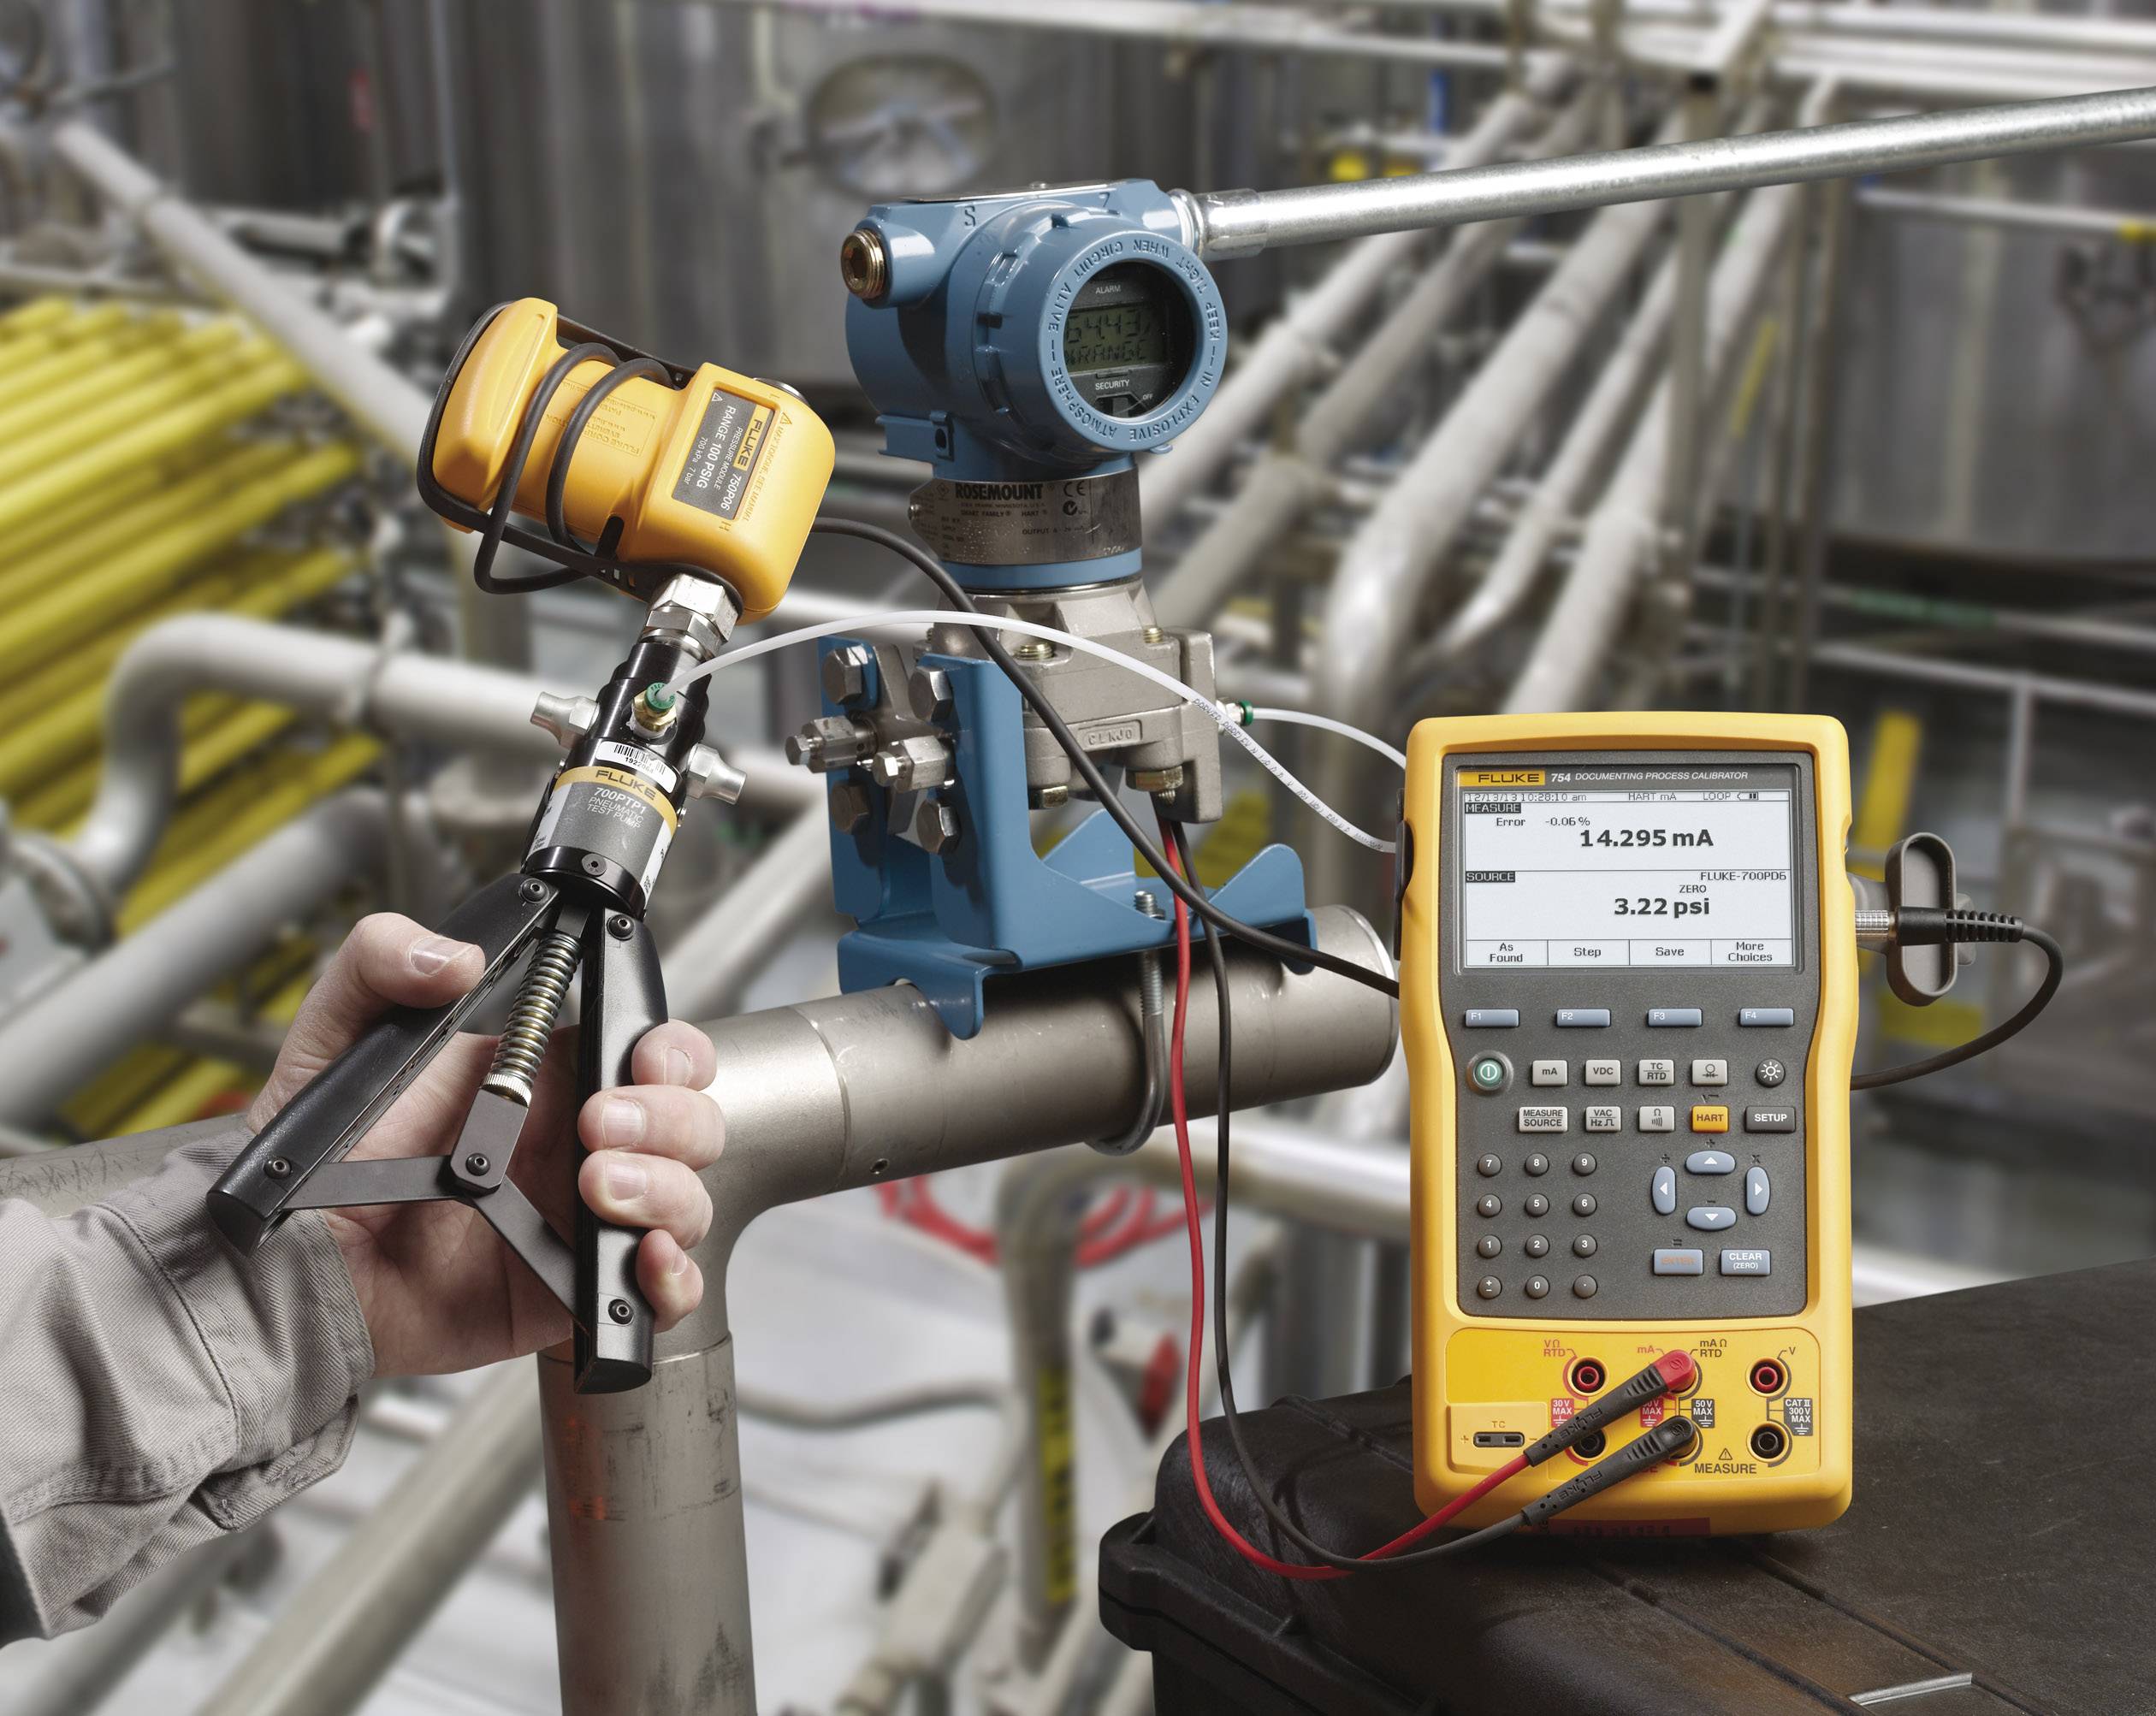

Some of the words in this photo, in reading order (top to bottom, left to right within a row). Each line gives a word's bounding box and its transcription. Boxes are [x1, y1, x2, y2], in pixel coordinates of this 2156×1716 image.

[1134, 239, 1169, 259] WHEN
[1074, 240, 1123, 281] CIRCUIT
[1176, 257, 1207, 294] TIGHT
[1095, 285, 1122, 294] ALARM
[1048, 281, 1072, 334] ALIVE
[1205, 302, 1220, 341] KEEP
[1201, 370, 1213, 388] IN
[1095, 380, 1130, 390] SECURITY
[1051, 367, 1117, 440] ATMOSPHERE
[715, 405, 737, 441] RANGE
[1129, 395, 1199, 441] EXPLOSIVE
[697, 437, 708, 452] 700
[726, 427, 743, 461] PRESSURE
[737, 419, 763, 467] FLUKE
[692, 450, 703, 463] kPa
[708, 442, 722, 461] 100
[684, 472, 694, 485] bar
[696, 461, 715, 488] PSIG
[714, 461, 730, 490] MODULE
[720, 473, 742, 511] 750P06
[956, 483, 1044, 500] ROSEMOUNT
[1478, 773, 1540, 783] FLUKE
[1551, 773, 1571, 783] 754
[1575, 772, 1644, 781] DOCUMENTING
[1646, 772, 1690, 780] PROCESS
[1691, 772, 1748, 780] CALIBRATOR
[595, 770, 656, 801] FLUKE
[595, 787, 647, 814] 700PTP1
[1466, 793, 1518, 802] 12/13/13
[1521, 793, 1568, 802] 10:28:10
[1628, 793, 1656, 802] HART
[1661, 793, 1677, 802] mA
[1703, 792, 1731, 801] LOOP
[589, 796, 643, 823] PNEUMATIC
[1466, 803, 1520, 813] MEASURE
[587, 804, 613, 815] TEST
[613, 812, 641, 828] PUMP
[1496, 817, 1525, 826] Error
[1545, 818, 1576, 826] -0.06
[1581, 830, 1667, 847] 14.295
[1673, 830, 1714, 847] mA
[1466, 872, 1514, 882] SOURCE
[1679, 885, 1707, 893] ZERO
[1614, 898, 1668, 915] 3.22
[1673, 897, 1710, 919] psi
[1499, 943, 1513, 952] As
[1736, 941, 1764, 951] More
[1574, 947, 1602, 958] Step
[1656, 947, 1685, 956] Save
[1490, 953, 1523, 962] Found
[1728, 952, 1773, 962] Choices
[1561, 1012, 1573, 1021] F2
[1744, 1011, 1756, 1020] F4
[1542, 1067, 1558, 1076] mA
[1593, 1067, 1614, 1075] VDC
[1650, 1062, 1663, 1071] TC
[1647, 1072, 1667, 1080] RTD
[1593, 1109, 1613, 1117] VAC
[1697, 1114, 1724, 1122] HART
[1754, 1113, 1787, 1122] SETUP
[1524, 1118, 1562, 1127] SOURCE
[1590, 1119, 1602, 1127] Hz
[1486, 1159, 1492, 1168] 7
[1534, 1159, 1539, 1168] 8
[1582, 1158, 1587, 1167] 9
[1534, 1199, 1539, 1208] 5
[1582, 1199, 1588, 1208] 6
[1582, 1240, 1588, 1249] 3
[1729, 1252, 1762, 1261] CLEAR
[1732, 1261, 1758, 1270] (ZERO)
[1534, 1281, 1540, 1290] 0
[1700, 1349, 1722, 1358] RTD
[1789, 1346, 1796, 1355] V
[1786, 1399, 1803, 1407] CAT
[1693, 1407, 1713, 1416] MAX
[1560, 1408, 1602, 1439] FLUKE
[1694, 1464, 1756, 1474] MEASURE
[1559, 1470, 1602, 1500] FLUKE
